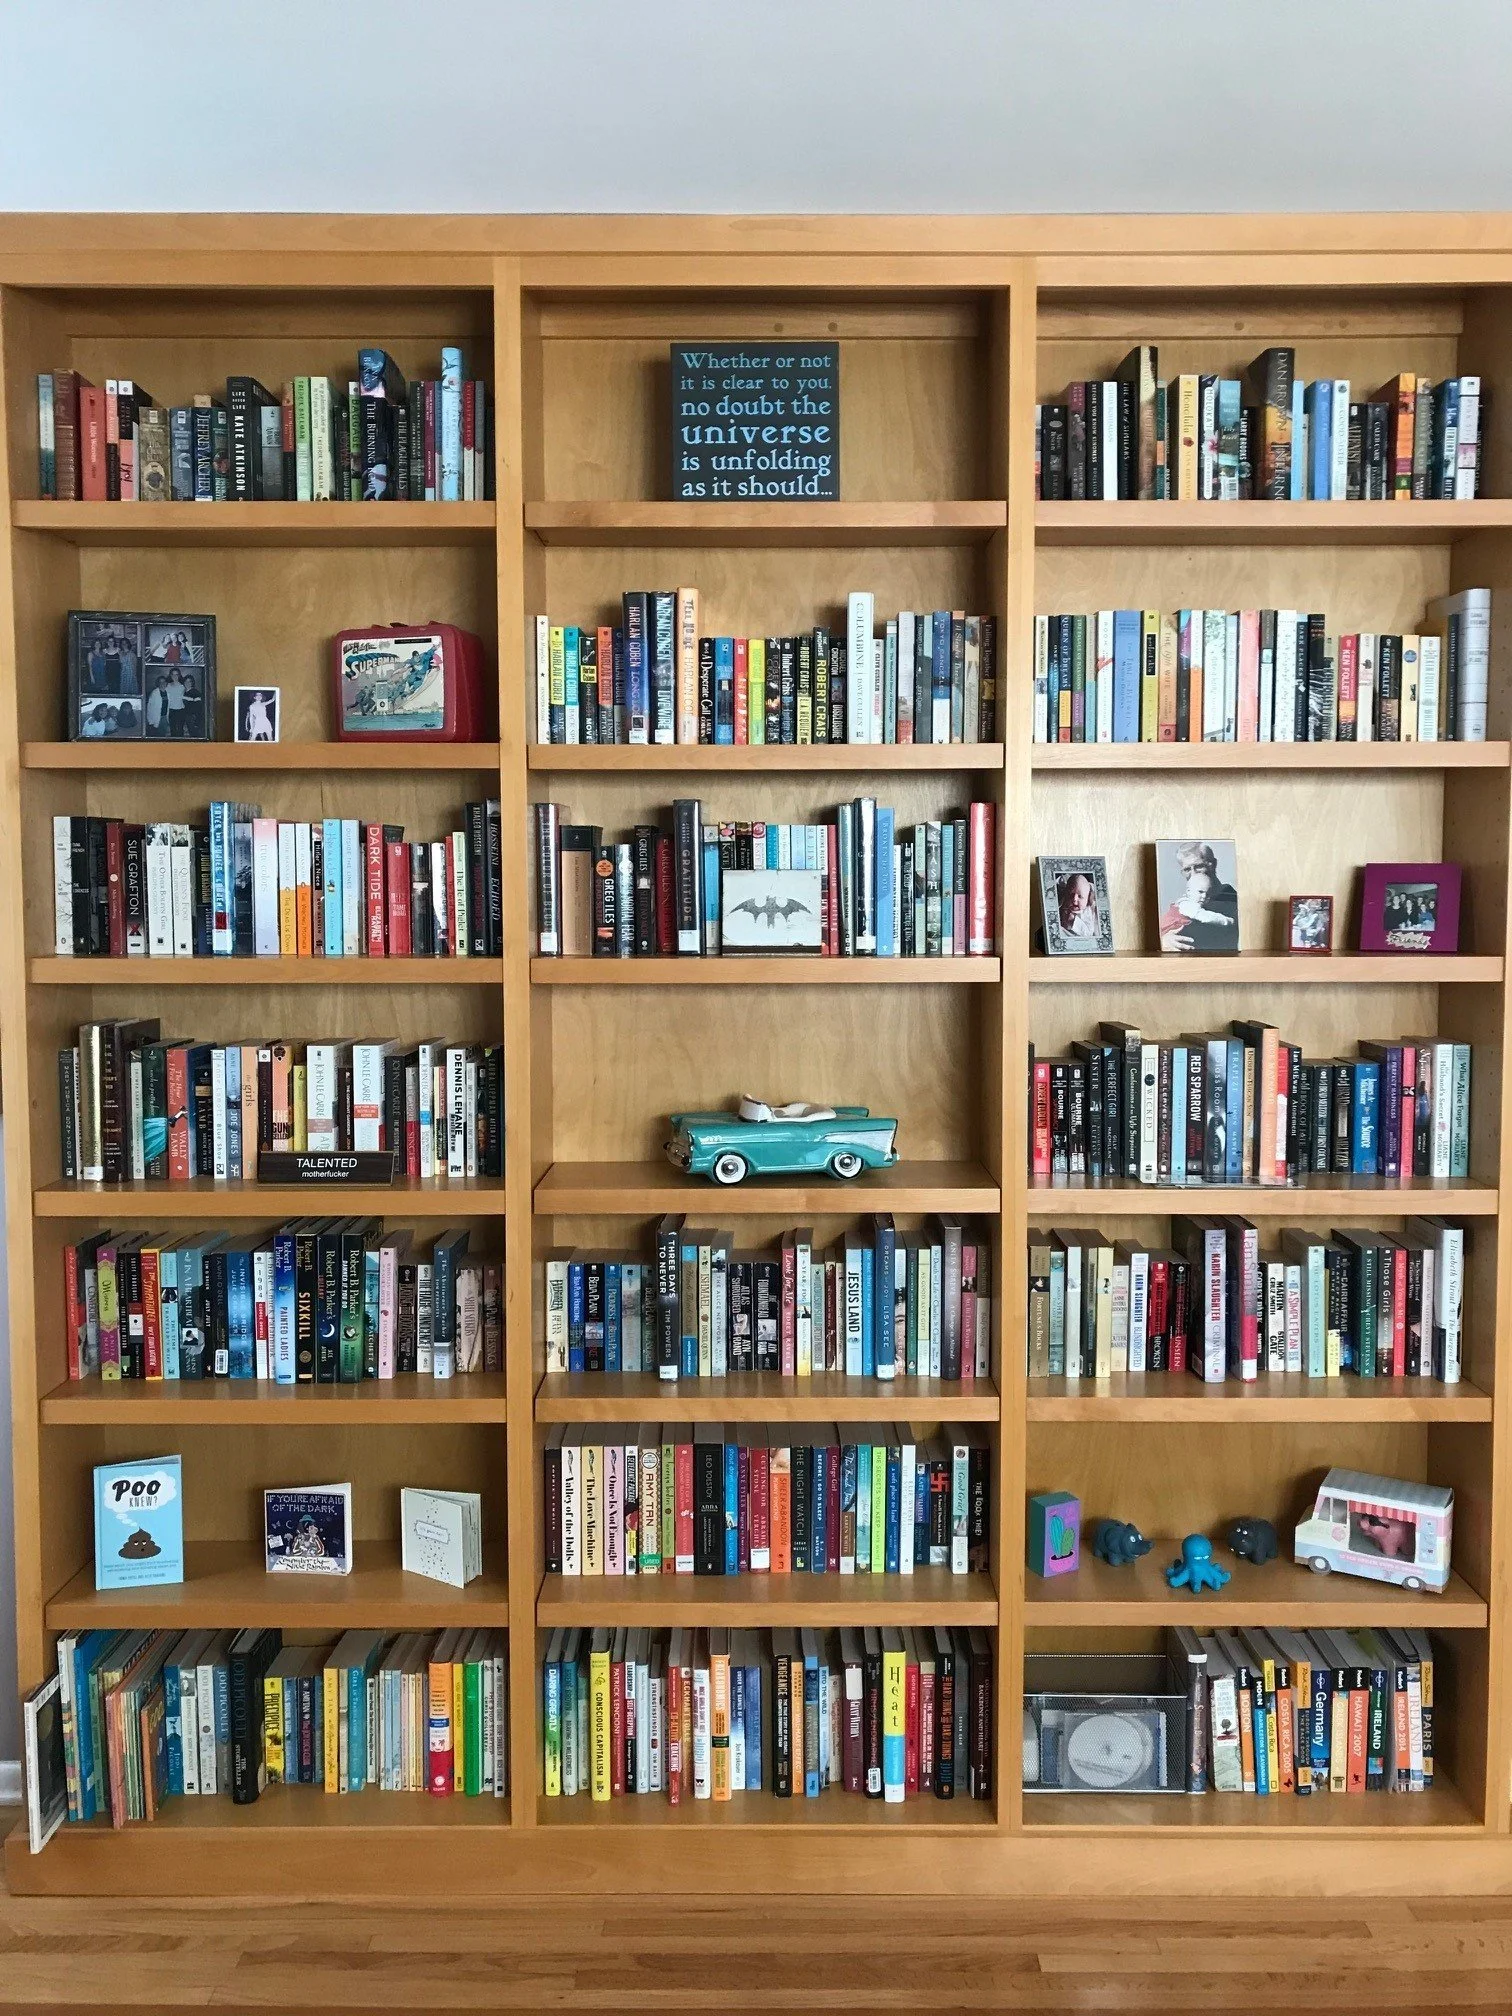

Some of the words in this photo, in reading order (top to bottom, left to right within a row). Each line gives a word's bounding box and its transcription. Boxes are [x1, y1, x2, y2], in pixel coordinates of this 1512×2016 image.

[681, 353, 770, 368] Whether
[776, 357, 795, 368] or
[800, 355, 831, 368] not
[1277, 352, 1288, 380] DAN
[681, 376, 694, 390] it
[702, 375, 715, 389] is
[722, 375, 763, 389] clear
[771, 377, 789, 389] to
[367, 402, 376, 421] THE
[681, 402, 710, 415] no
[716, 395, 785, 415] doubt
[791, 394, 831, 414] the
[1277, 385, 1288, 432] BROWN
[196, 414, 211, 451] JEFFREY
[235, 416, 243, 438] KATE
[681, 419, 830, 444] universe
[367, 424, 376, 464] BURNING
[197, 454, 211, 492] ARCHER
[236, 444, 245, 491] ATKINSON
[681, 451, 699, 470] is
[711, 449, 831, 476] unfolding
[682, 482, 706, 496] as
[712, 477, 731, 495] it
[738, 475, 832, 495] should...
[629, 607, 640, 638] HARLAN
[657, 597, 670, 630] HARLAN
[657, 631, 670, 660] COBEN
[856, 602, 864, 668] COLUMBINE
[630, 642, 641, 667] COBEN
[1342, 650, 1350, 666] KEN
[1382, 648, 1390, 664] KEN
[345, 656, 400, 680] SUPERMAN
[700, 662, 713, 697] Desperate
[817, 659, 827, 703] ROBERT
[1341, 667, 1351, 699] FOLLETT
[1382, 666, 1390, 697] FOLLETT
[657, 690, 669, 707] LIVE
[702, 699, 712, 714] Call
[658, 707, 670, 728] WIRE
[816, 706, 826, 737] CRAIS
[127, 840, 137, 860] SUE
[369, 827, 380, 865] DARK
[128, 862, 139, 915] GRAFTON
[370, 870, 380, 900] TIDE
[456, 870, 464, 886] The
[682, 849, 692, 922] GRATITUDE
[457, 888, 464, 898] Te
[604, 879, 614, 902] GREG
[456, 909, 465, 932] Piglet
[604, 904, 614, 923] ILES
[1191, 1055, 1202, 1073] RED
[1292, 1051, 1300, 1063] Ian
[454, 1054, 462, 1093] DENNIS
[1292, 1065, 1300, 1094] McEwan
[1459, 1062, 1467, 1082] What
[243, 1084, 255, 1107] girls
[1190, 1076, 1202, 1121] SPARROW
[1456, 1082, 1465, 1104] Alice
[230, 1112, 238, 1127] JOE
[454, 1095, 462, 1136] LEHANE
[1456, 1106, 1464, 1128] Forgot
[171, 1133, 179, 1157] LAMB
[296, 1158, 358, 1168] TALENTED
[302, 1170, 350, 1178] motherfucker
[349, 1250, 359, 1276] Robert
[659, 1245, 666, 1257] TO
[325, 1251, 336, 1277] Robert
[785, 1254, 793, 1275] Look
[1212, 1254, 1221, 1276] KARIN
[1383, 1257, 1392, 1286] Those
[326, 1278, 335, 1289] B.
[350, 1278, 359, 1288] B.
[668, 1275, 676, 1298] DAYS
[784, 1276, 794, 1288] for
[848, 1271, 859, 1303] JESUS
[326, 1290, 336, 1320] Parker's
[349, 1289, 359, 1320] Parker's
[732, 1278, 741, 1314] SHRUGGED
[740, 1285, 750, 1305] ATLAS
[785, 1290, 793, 1303] Me
[1211, 1279, 1221, 1321] SLAUGHTER
[1382, 1290, 1390, 1312] Girls
[280, 1307, 288, 1335] PAINTED
[298, 1292, 311, 1340] SIXKILL
[848, 1306, 860, 1332] LAND
[280, 1337, 288, 1361] LADIES
[705, 1455, 713, 1469] LEO
[796, 1449, 804, 1466] THE
[564, 1476, 574, 1503] Valley
[586, 1476, 596, 1497] The
[608, 1476, 618, 1499] Once
[646, 1473, 654, 1498] AMY
[705, 1470, 713, 1498] TOLSTOY
[796, 1470, 804, 1499] NIGHT
[129, 1496, 158, 1508] KNEW?
[272, 1504, 285, 1512] OF
[287, 1504, 306, 1512] THE
[310, 1496, 344, 1504] AFRAID
[565, 1506, 574, 1517] of
[586, 1497, 595, 1520] Love
[608, 1500, 618, 1509] Is
[565, 1520, 574, 1534] the
[608, 1510, 618, 1525] Not
[646, 1504, 654, 1527] TAN
[796, 1503, 804, 1536] WATCH
[565, 1537, 574, 1561] Dolls
[586, 1520, 596, 1561] Machine
[607, 1525, 618, 1562] Enough
[218, 1670, 227, 1693] JODI
[548, 1669, 556, 1698] DARING
[778, 1658, 788, 1696] VENGEANCE
[219, 1694, 228, 1733] PICOULT
[265, 1693, 280, 1731] PRECIPICE
[549, 1699, 557, 1732] GREATLY
[596, 1692, 604, 1731] CONSCIOUS
[1242, 1694, 1250, 1732] BOSTON
[1281, 1698, 1290, 1726] COSTA
[1313, 1692, 1326, 1746] Germany
[1282, 1729, 1291, 1750] RICA
[1372, 1710, 1381, 1749] IRELAND
[1423, 1714, 1432, 1751] PARIS
[596, 1734, 604, 1776] CAPITALISM
[1353, 1735, 1362, 1757] 2007
